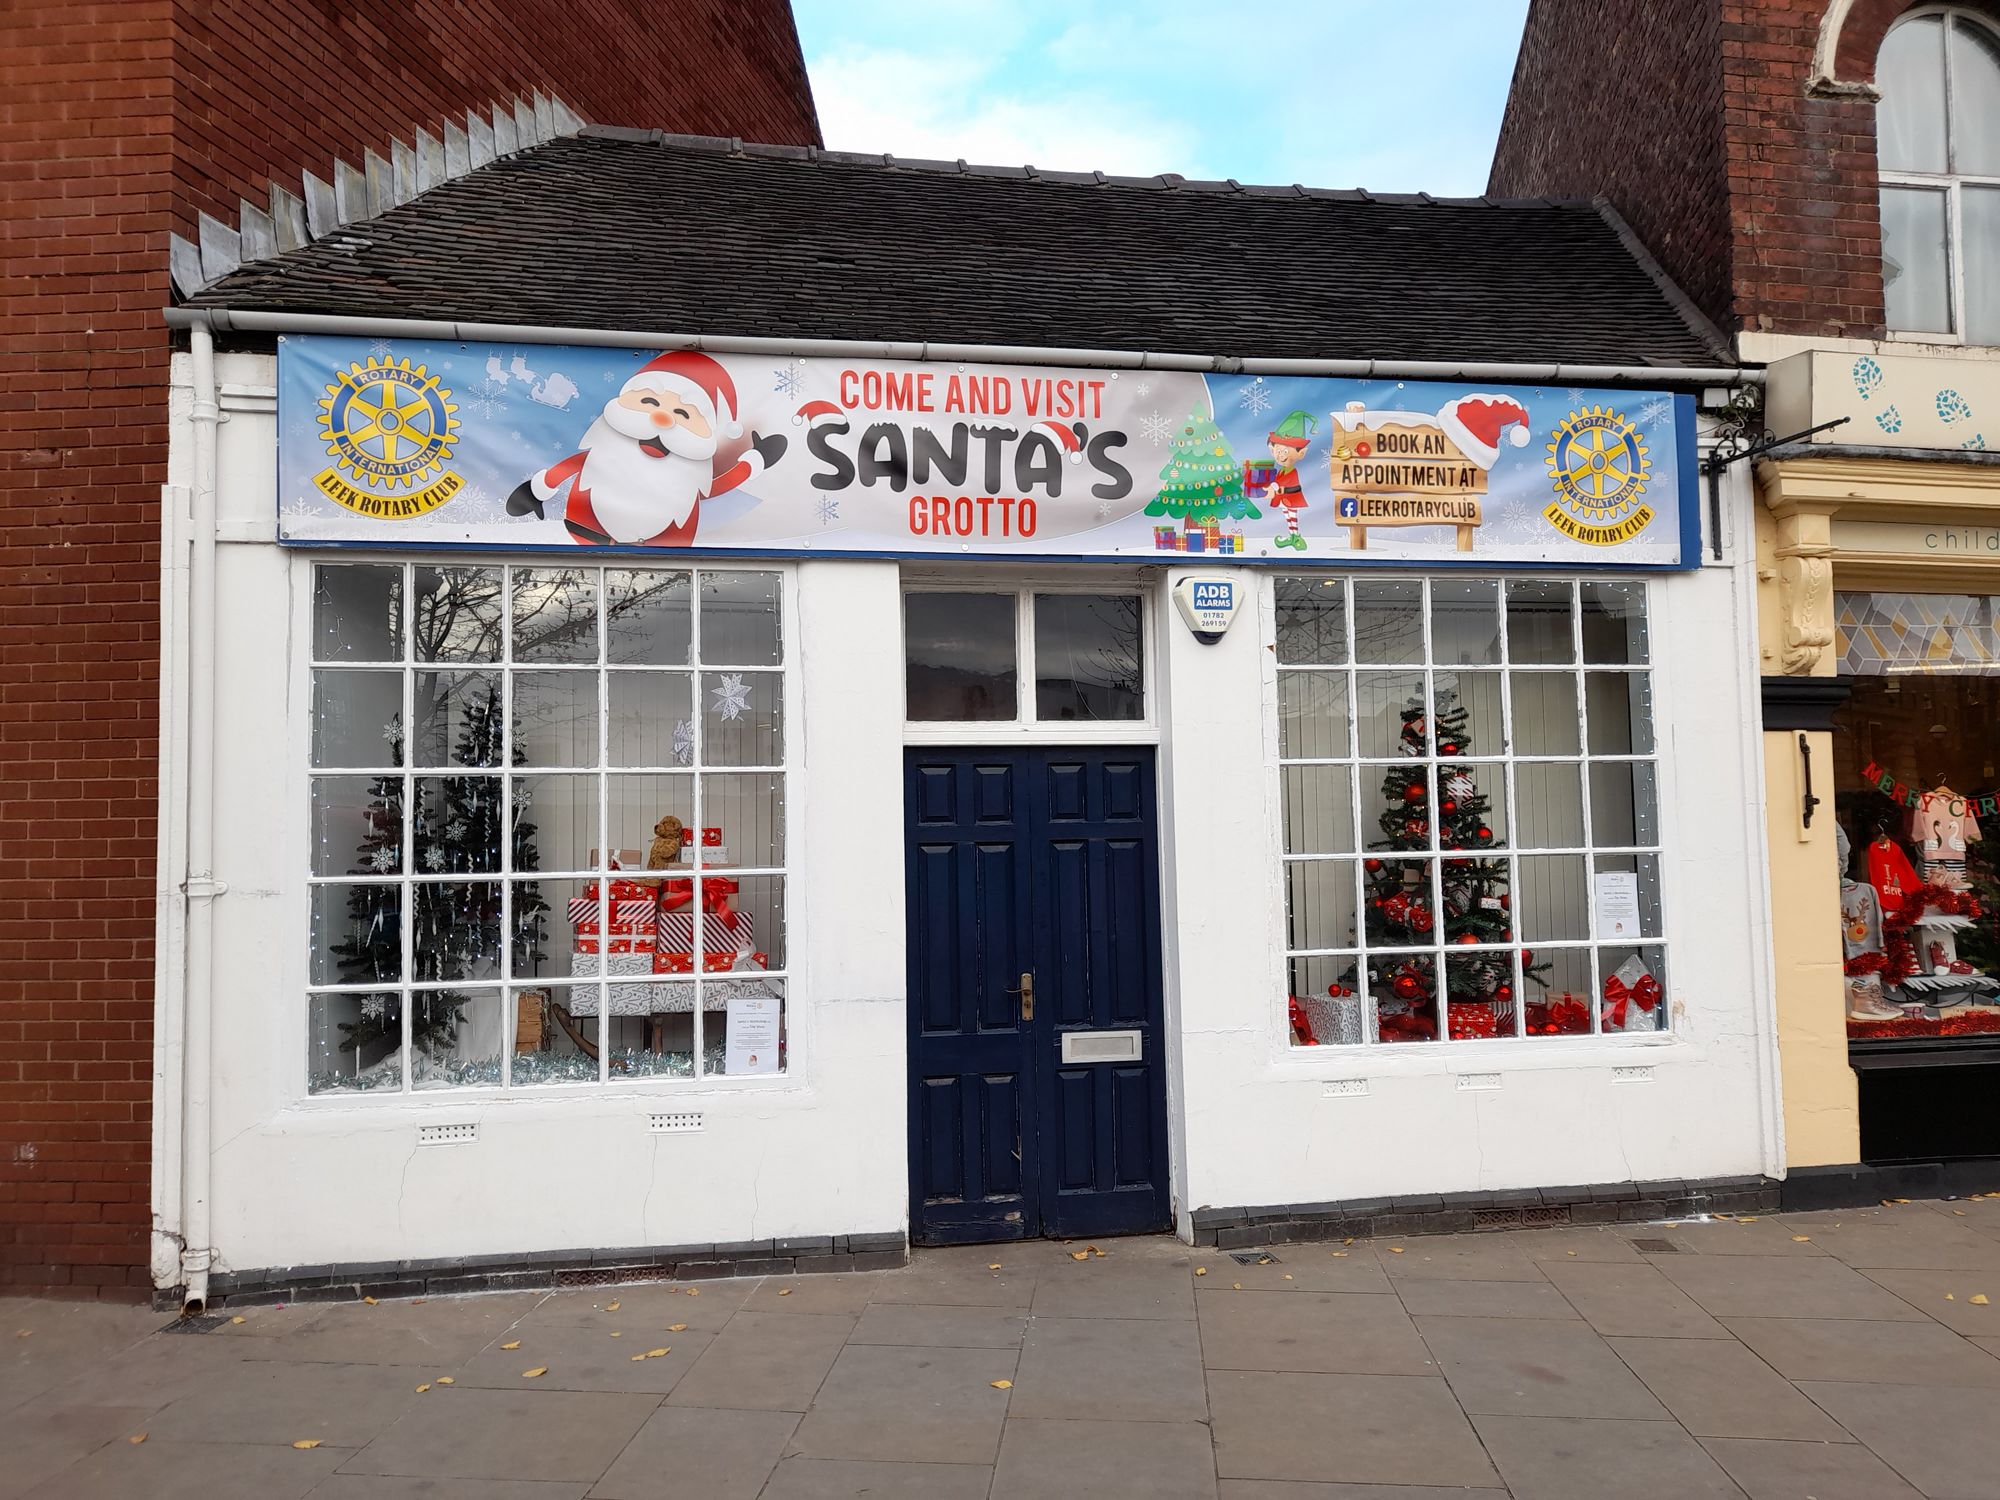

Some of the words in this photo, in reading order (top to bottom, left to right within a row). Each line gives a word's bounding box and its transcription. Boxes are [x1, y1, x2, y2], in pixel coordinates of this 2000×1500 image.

[359, 370, 420, 386] ROTARY
[840, 369, 934, 412] COME
[945, 375, 1012, 415] AND
[1020, 378, 1106, 418] VISIT
[1576, 416, 1620, 432] ROTARY
[340, 441, 441, 475] INTERNATIONAL
[1376, 433, 1420, 454] BOOK
[1423, 435, 1445, 455] AN
[806, 420, 1134, 500] SANTA'S
[1341, 464, 1455, 487] APPOINTMENT
[1459, 467, 1478, 488] AT
[320, 474, 360, 508] LEEK
[359, 496, 423, 516] ROTARY
[423, 476, 460, 507] CLUB
[1563, 479, 1639, 508] INTERNATIONAL
[909, 495, 1038, 538] GROTTO
[1360, 499, 1476, 519] LEEKROTARYCLUB
[1548, 508, 1578, 535] LEEK
[1578, 526, 1624, 543] ROTARY
[1624, 508, 1651, 535] CLUB
[1925, 530, 2000, 551] child
[1197, 586, 1229, 598] ADB
[1861, 760, 1936, 813] MERRY
